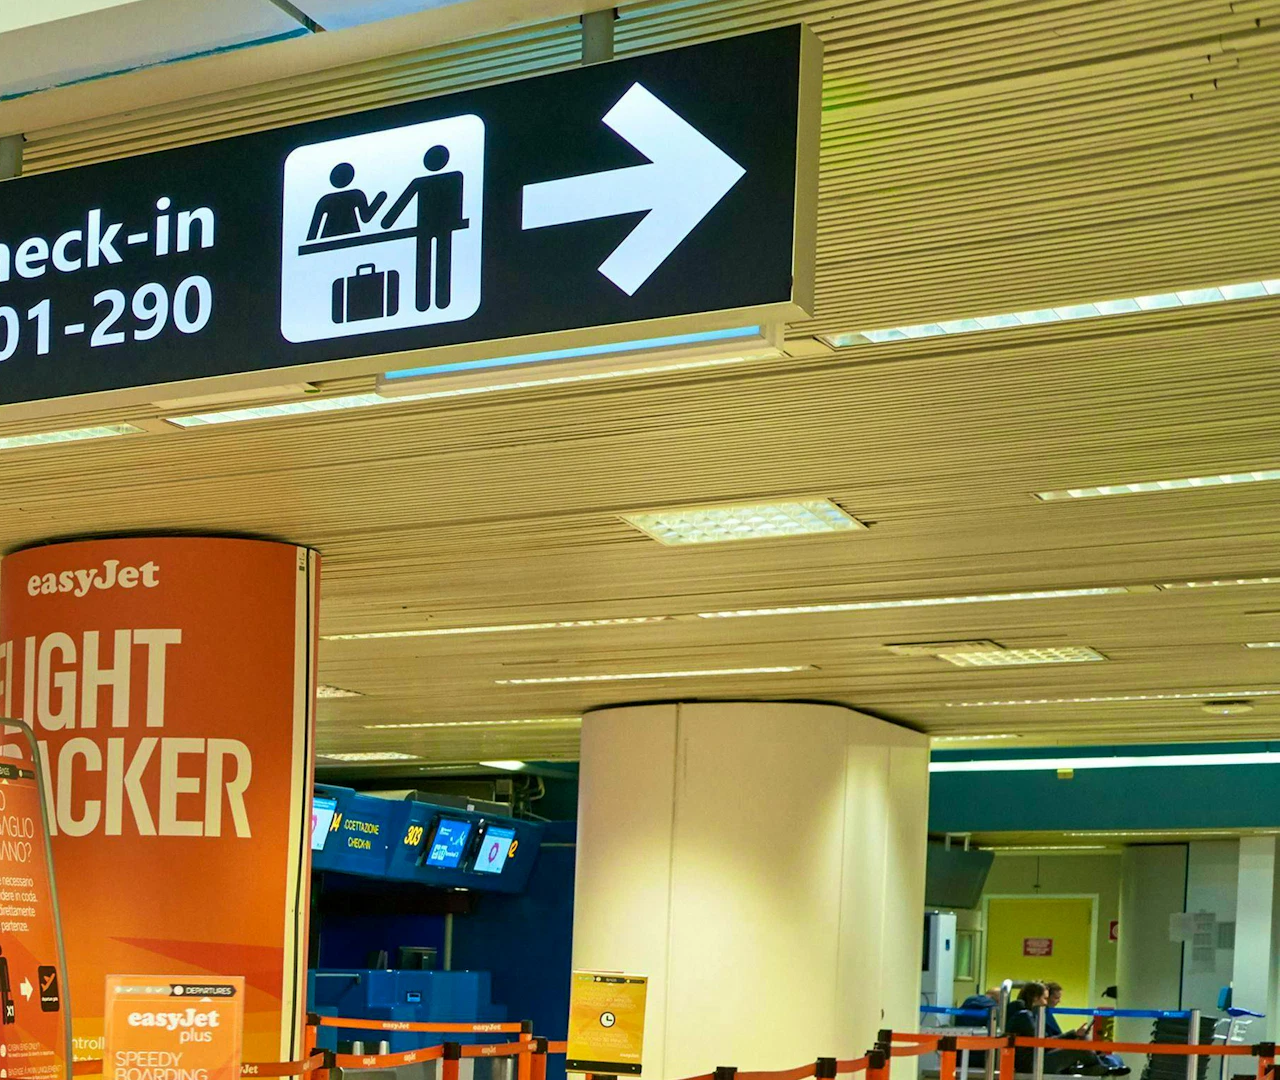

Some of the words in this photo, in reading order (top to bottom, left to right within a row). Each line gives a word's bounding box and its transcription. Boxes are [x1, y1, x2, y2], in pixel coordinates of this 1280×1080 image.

[27, 560, 159, 597] easyJet
[404, 826, 424, 846] 303
[185, 987, 232, 995] DEPARTURES
[128, 1008, 220, 1030] easyJet
[383, 1022, 410, 1030] easyJet
[473, 1023, 502, 1031] easyJet
[180, 1029, 212, 1044] plus
[115, 1051, 183, 1067] SPEEDY
